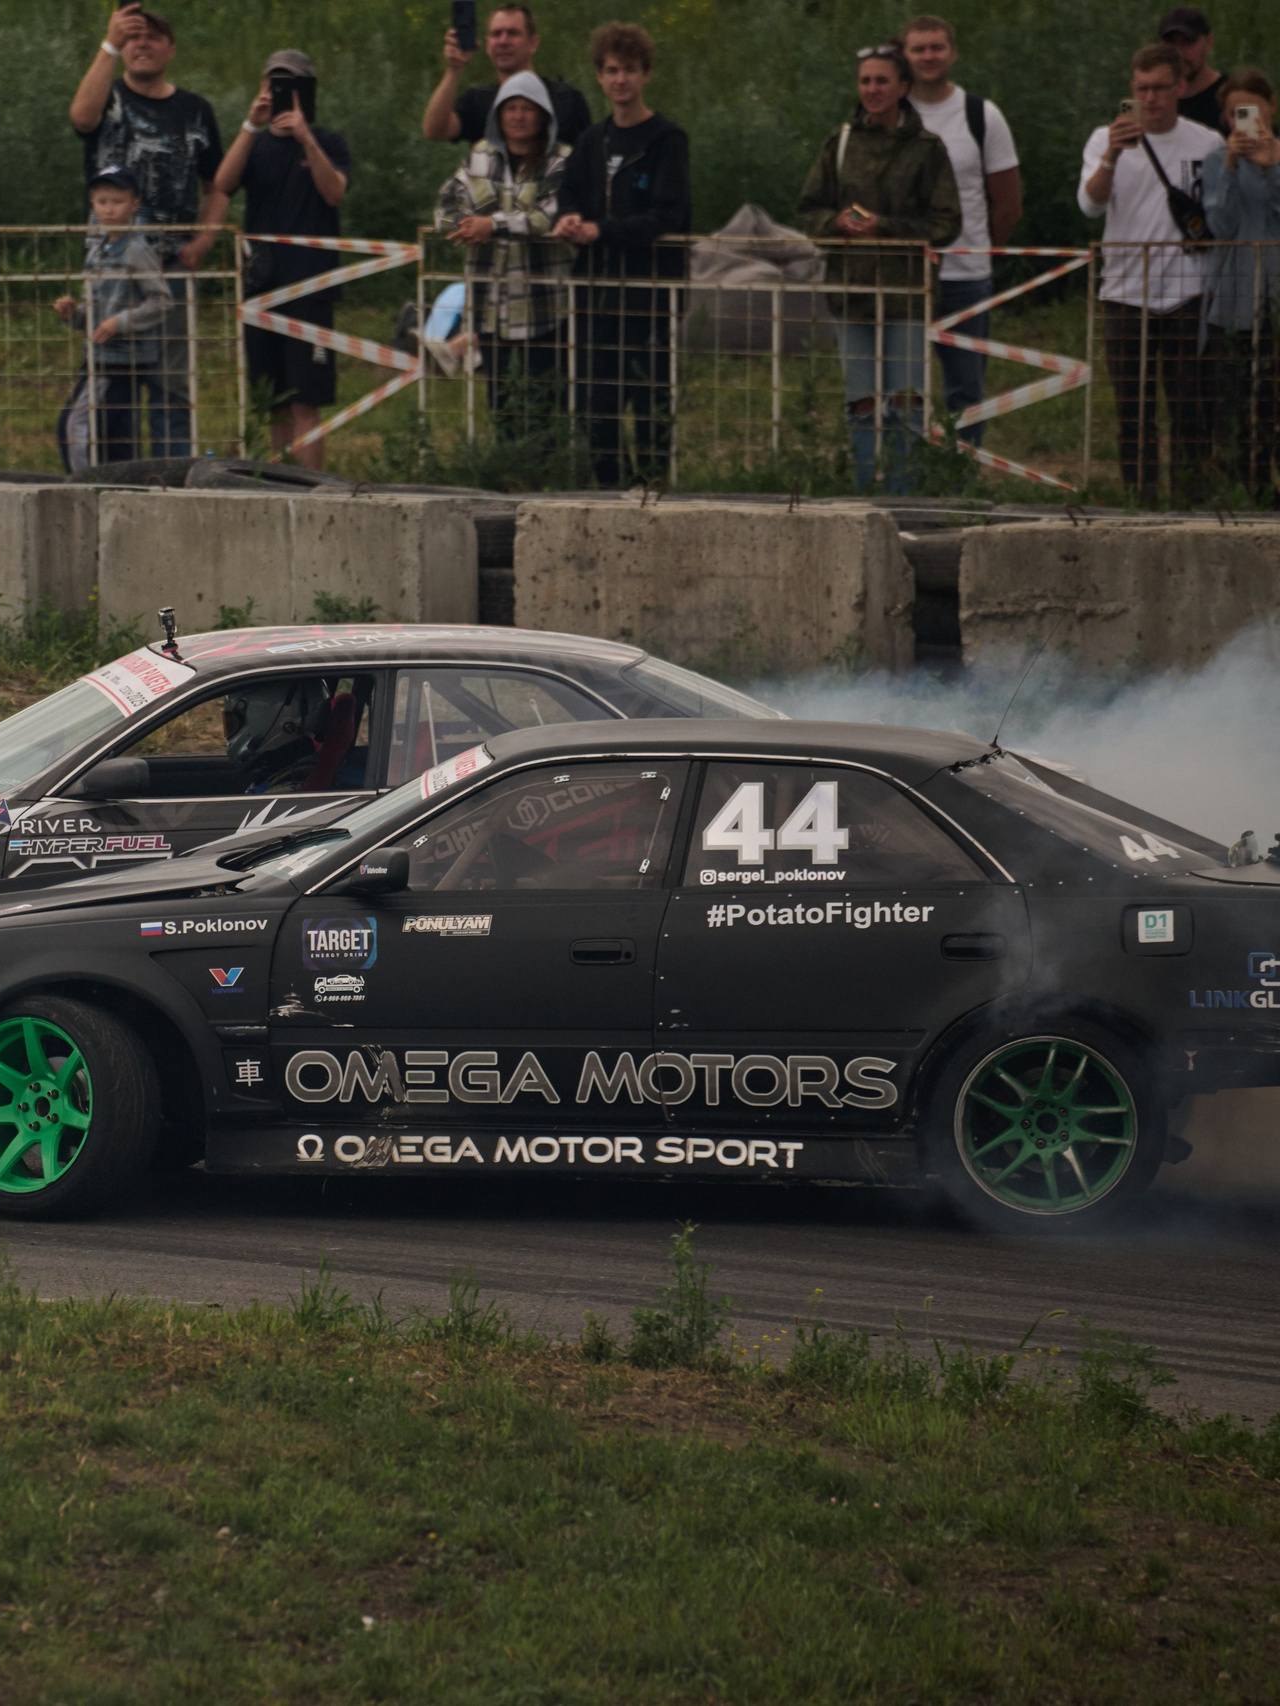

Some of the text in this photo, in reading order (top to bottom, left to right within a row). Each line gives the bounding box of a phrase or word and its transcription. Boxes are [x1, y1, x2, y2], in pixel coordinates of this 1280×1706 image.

[20, 818, 102, 834] RIVER
[702, 781, 849, 865] 44
[8, 835, 172, 856] HYPERFUEL
[1119, 833, 1181, 863] 44
[164, 919, 268, 935] S.Poklonov
[402, 915, 491, 932] PONULYAM
[707, 902, 935, 929] #PotatoFighter
[1145, 914, 1167, 928] D1
[307, 929, 371, 952] TARGET
[235, 1058, 264, 1087] 車
[285, 1050, 898, 1109] OMEGA MOTORS
[493, 1136, 646, 1164] MOTOR
[654, 1137, 804, 1169] SPORT
